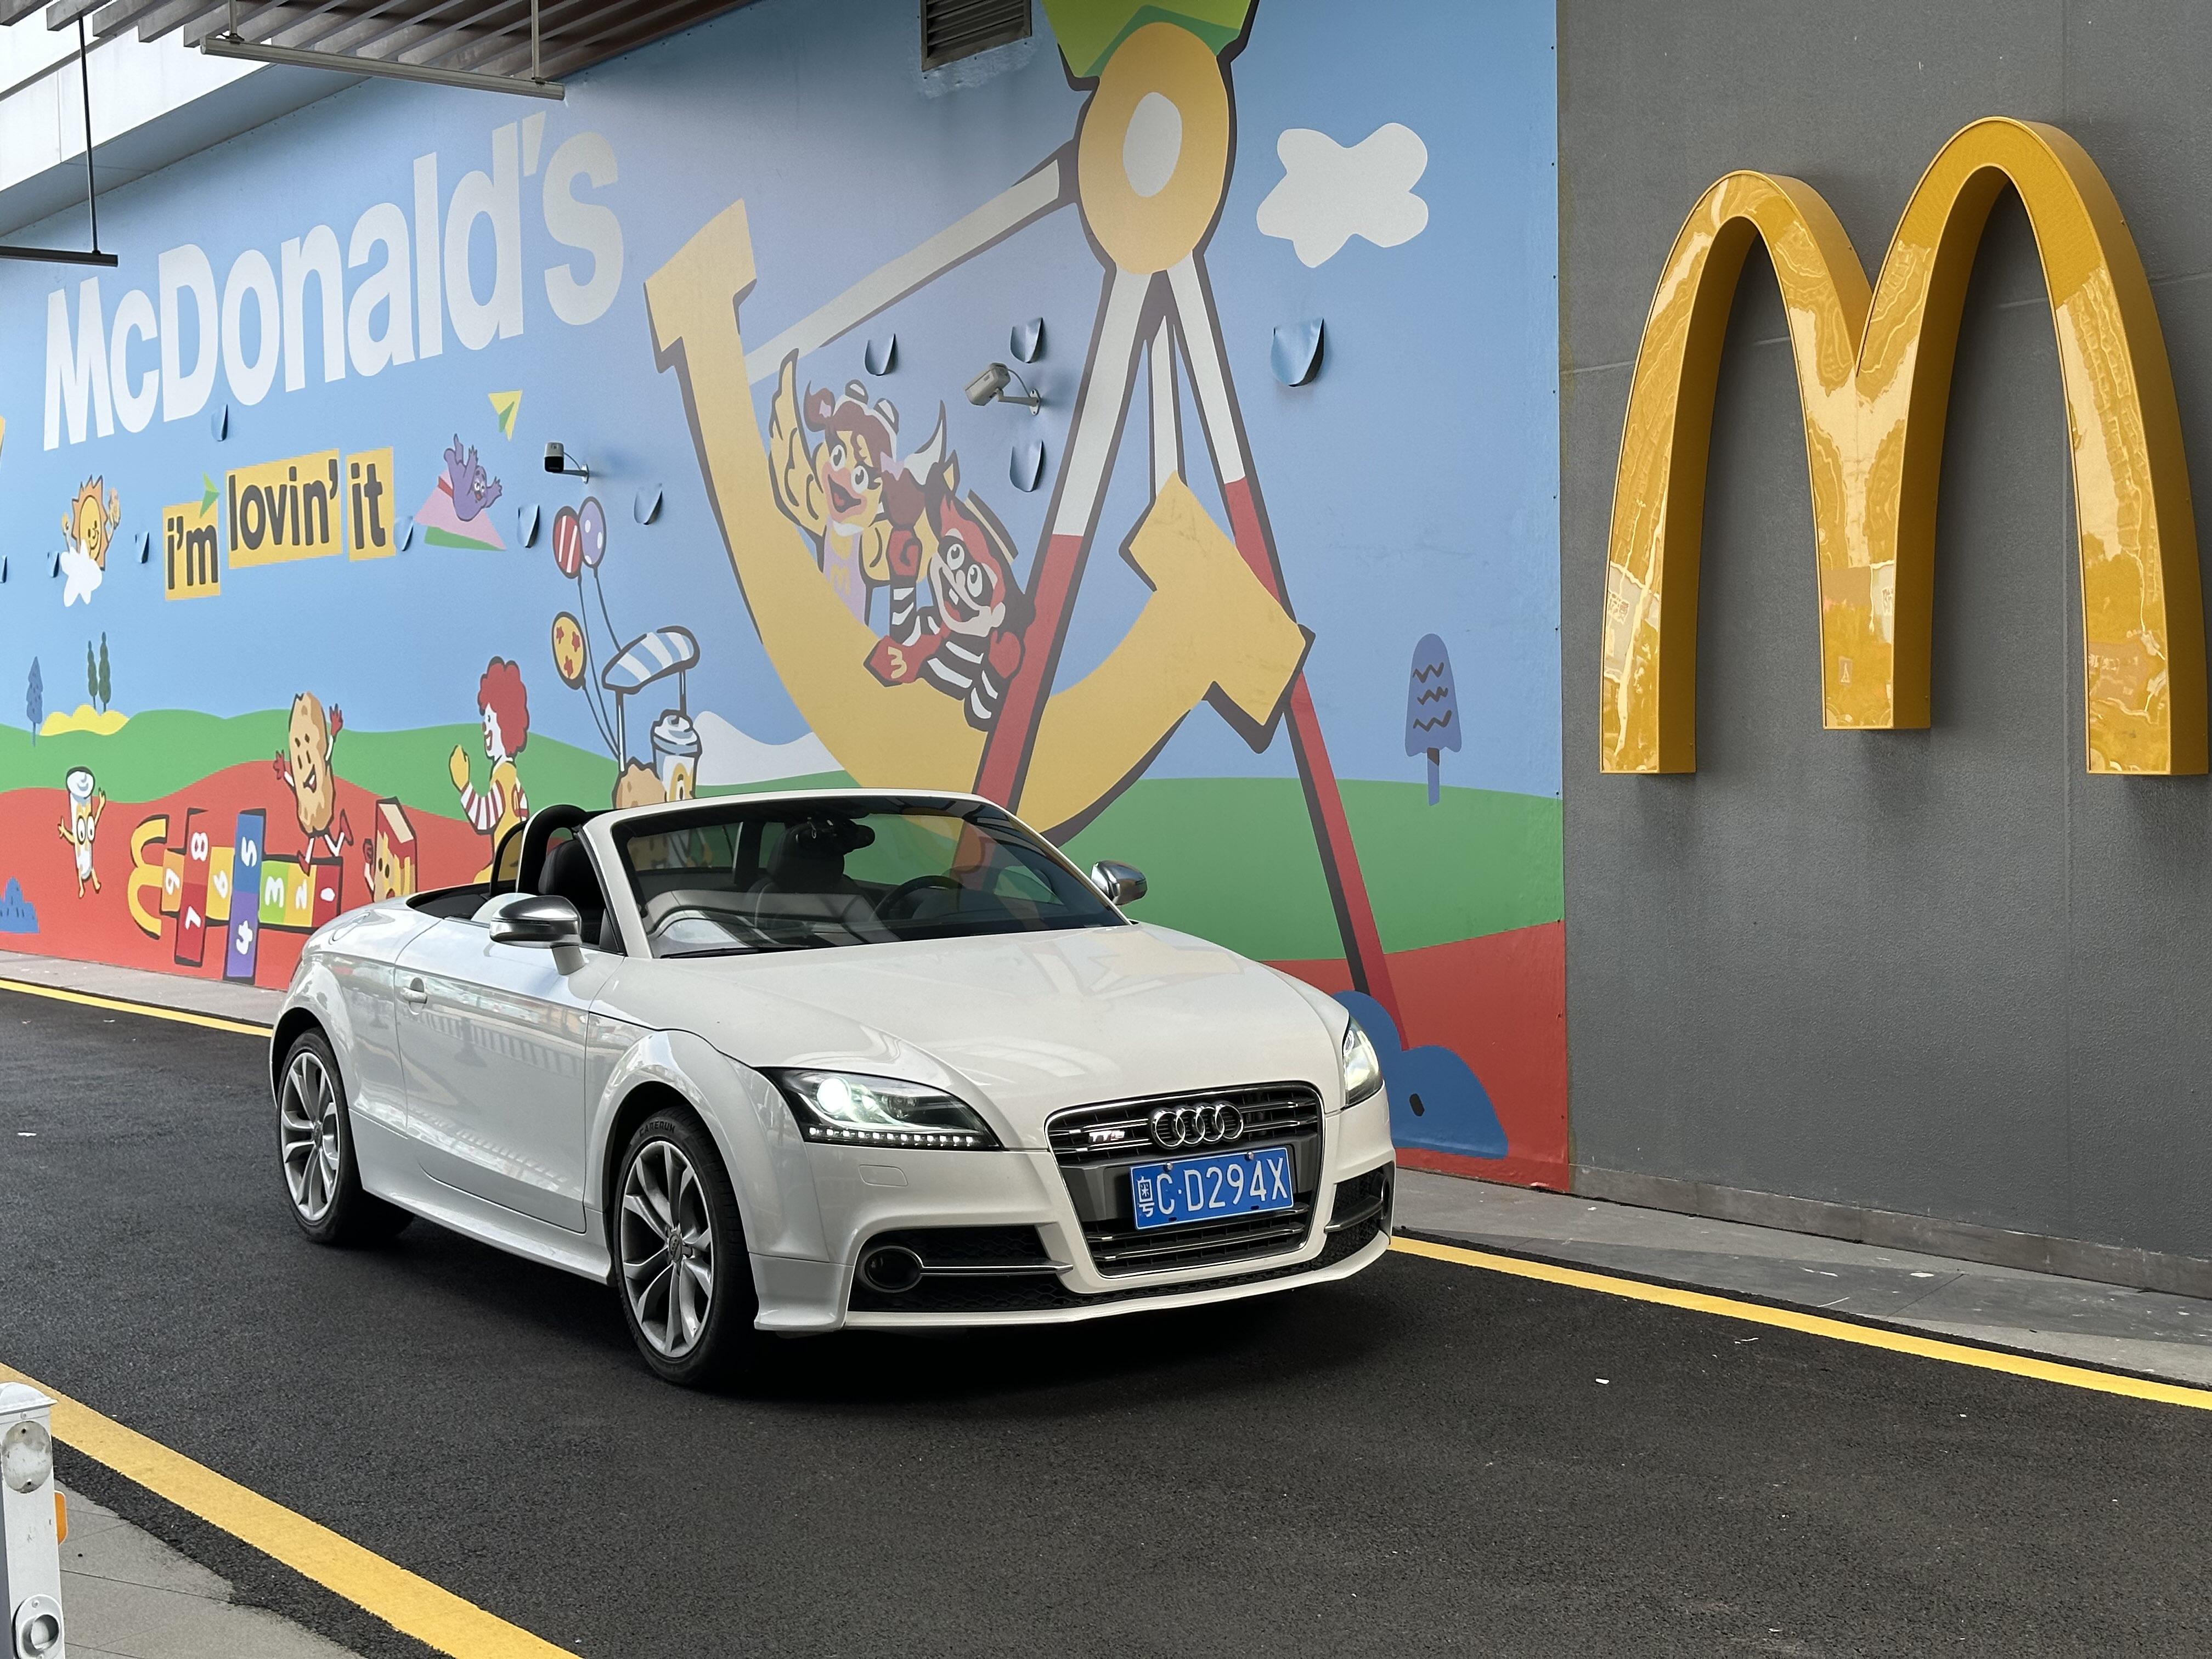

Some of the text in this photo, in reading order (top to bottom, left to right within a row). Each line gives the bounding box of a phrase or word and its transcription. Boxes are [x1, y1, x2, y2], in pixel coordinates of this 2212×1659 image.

[44, 111, 624, 452] McDonald's
[168, 459, 386, 590] i'm lovin' it
